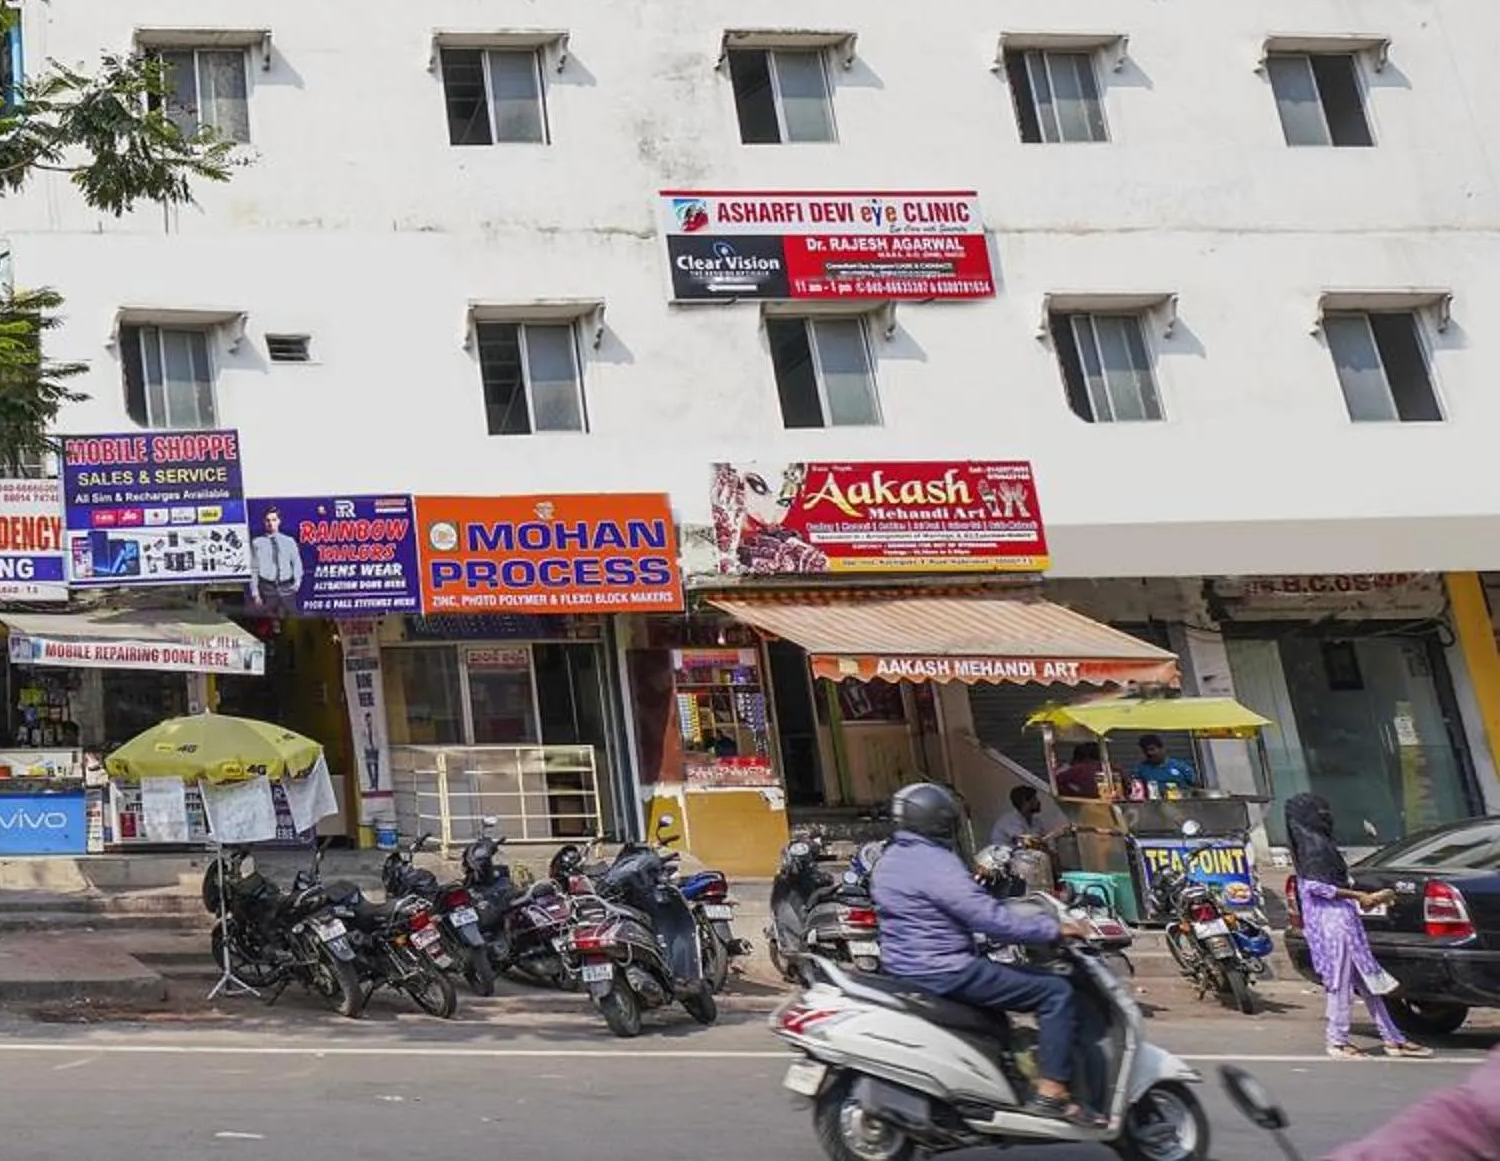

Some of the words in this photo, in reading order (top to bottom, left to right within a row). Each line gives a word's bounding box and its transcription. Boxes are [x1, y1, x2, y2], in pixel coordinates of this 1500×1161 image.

[717, 202, 803, 223] ASHARFI
[809, 202, 854, 223] DEVI
[903, 202, 970, 223] CLINIC
[806, 238, 827, 251] Dr.
[830, 237, 887, 252] RAJESH
[892, 236, 964, 251] AGARWAL
[676, 255, 721, 271] Clear
[725, 255, 780, 270] Vision
[66, 437, 149, 466] MOBILE
[152, 434, 237, 464] SHOPPE
[78, 469, 133, 486] SALES
[139, 469, 150, 485] &
[156, 466, 228, 484] SERVICE
[75, 493, 90, 504] All
[92, 492, 112, 504] Sim
[114, 492, 123, 502] &
[126, 490, 180, 504] Recharges
[183, 488, 230, 500] Available
[803, 469, 974, 517] Aakash
[868, 507, 949, 520] Mehandi
[952, 507, 986, 520] Art
[300, 519, 409, 545] RAINBOW
[467, 518, 668, 552] MOHAN
[314, 564, 357, 577] MENS
[361, 562, 403, 576] WEAR
[429, 556, 672, 590] PROCESS
[461, 594, 498, 607] PHOTO
[500, 593, 548, 606] POLYMER
[550, 593, 557, 604] &
[560, 593, 593, 605] FLEXO
[595, 592, 629, 604] BLOCK
[631, 590, 674, 603] MAKERS
[45, 643, 91, 660] MOBILE
[96, 645, 160, 663] REPAIRING
[163, 648, 195, 664] DONE
[199, 650, 230, 666] HERE
[876, 658, 950, 675] AAKASH
[955, 660, 1037, 677] MEHANDI
[1043, 661, 1079, 677] ART
[1144, 848, 1185, 873] TEA
[1188, 847, 1245, 875] POINT
